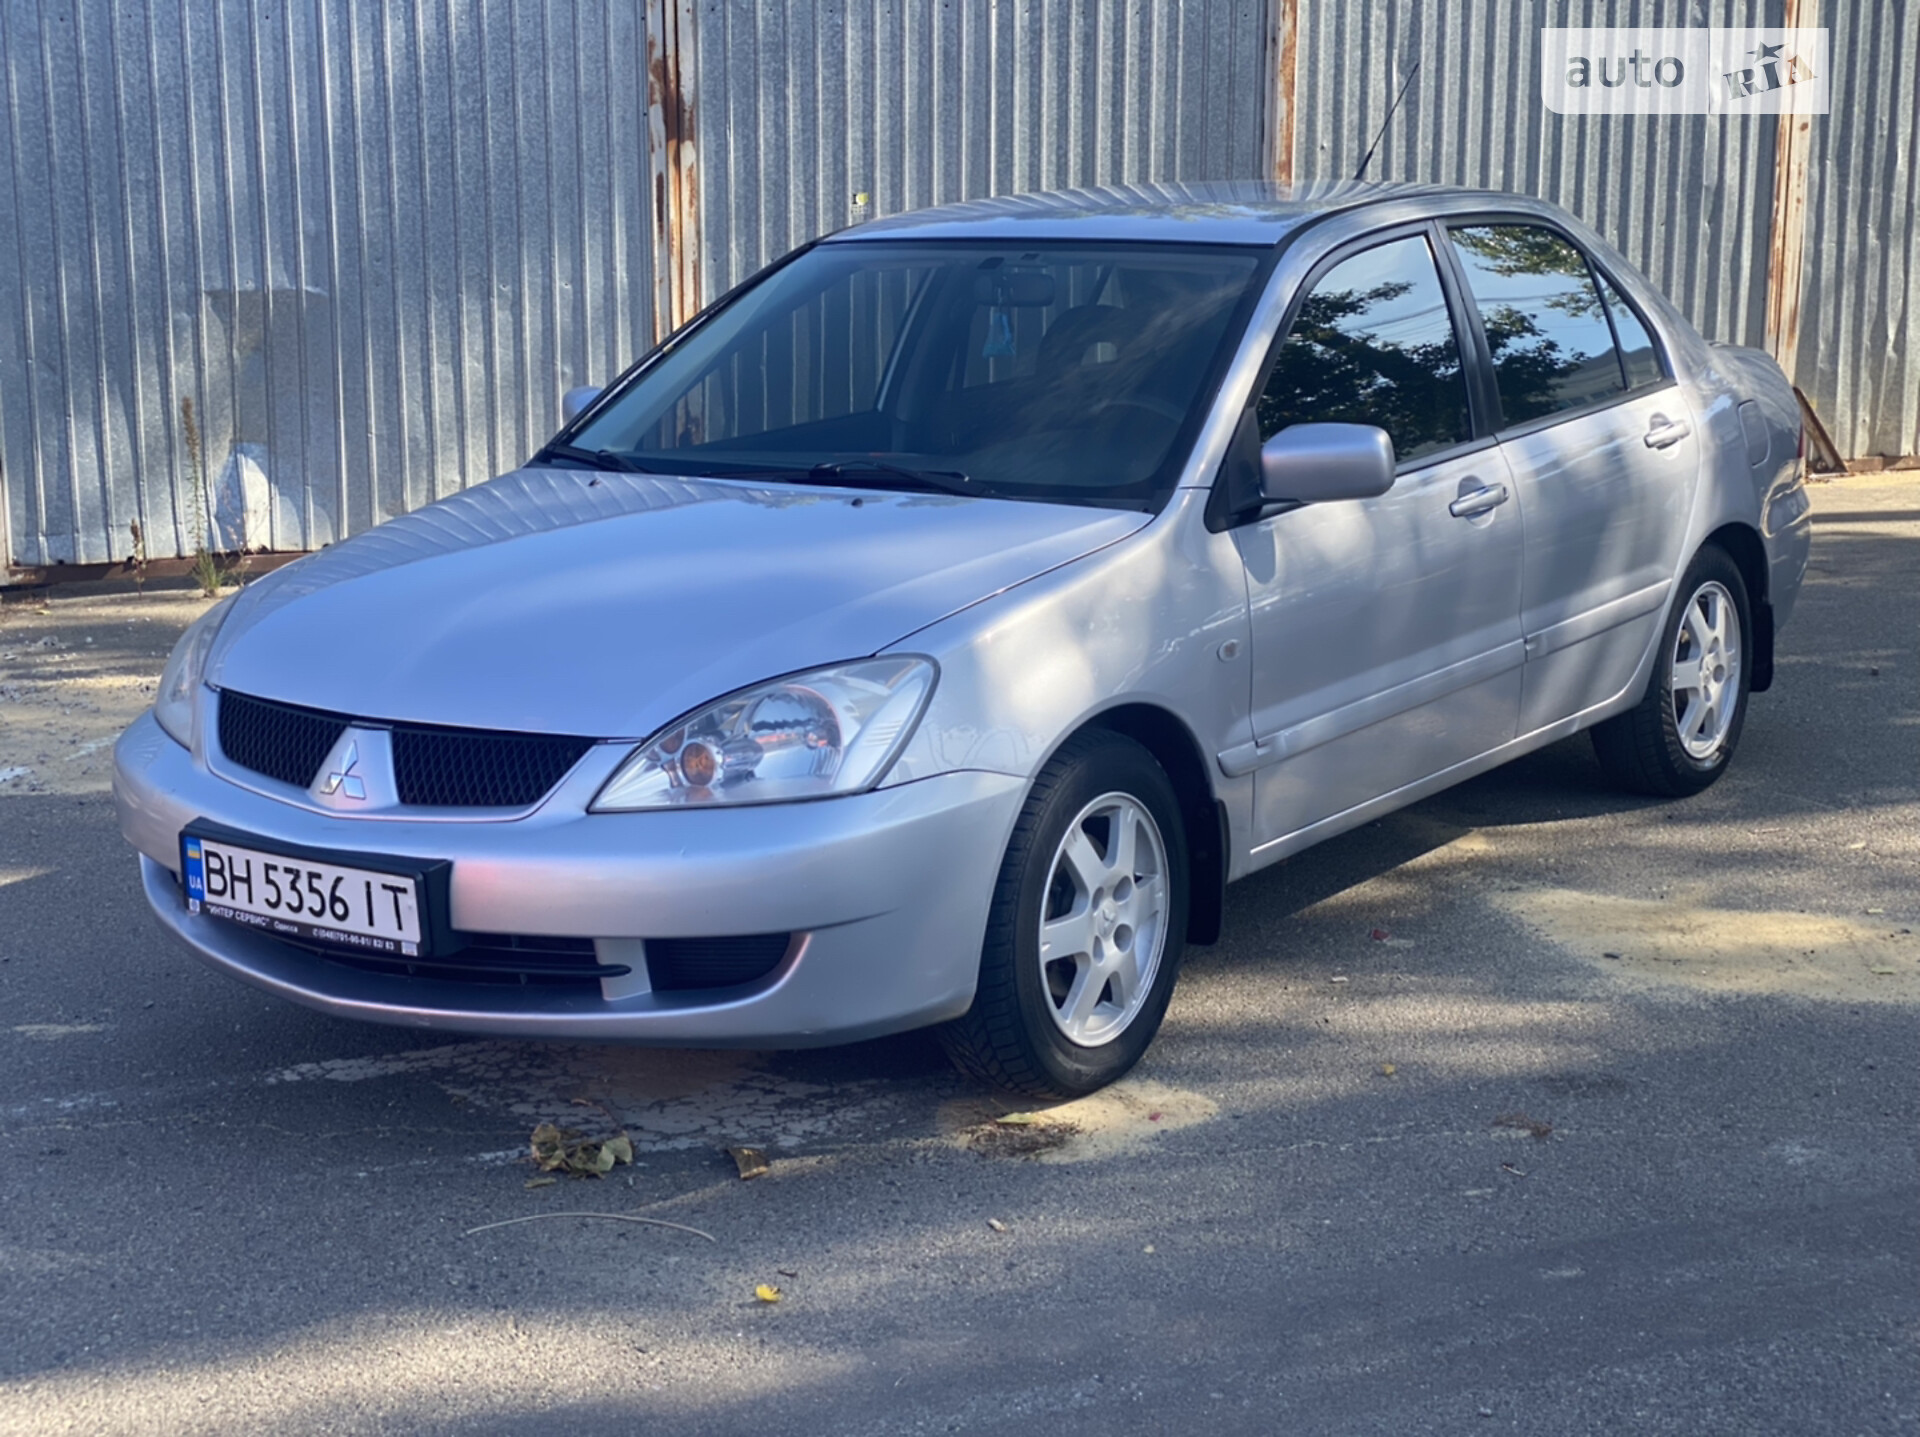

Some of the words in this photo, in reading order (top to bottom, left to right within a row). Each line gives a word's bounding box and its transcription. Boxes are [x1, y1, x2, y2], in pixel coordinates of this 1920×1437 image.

[188, 874, 203, 890] UA
[204, 849, 254, 905] BH
[263, 862, 350, 922] 5356
[364, 880, 409, 931] IT
